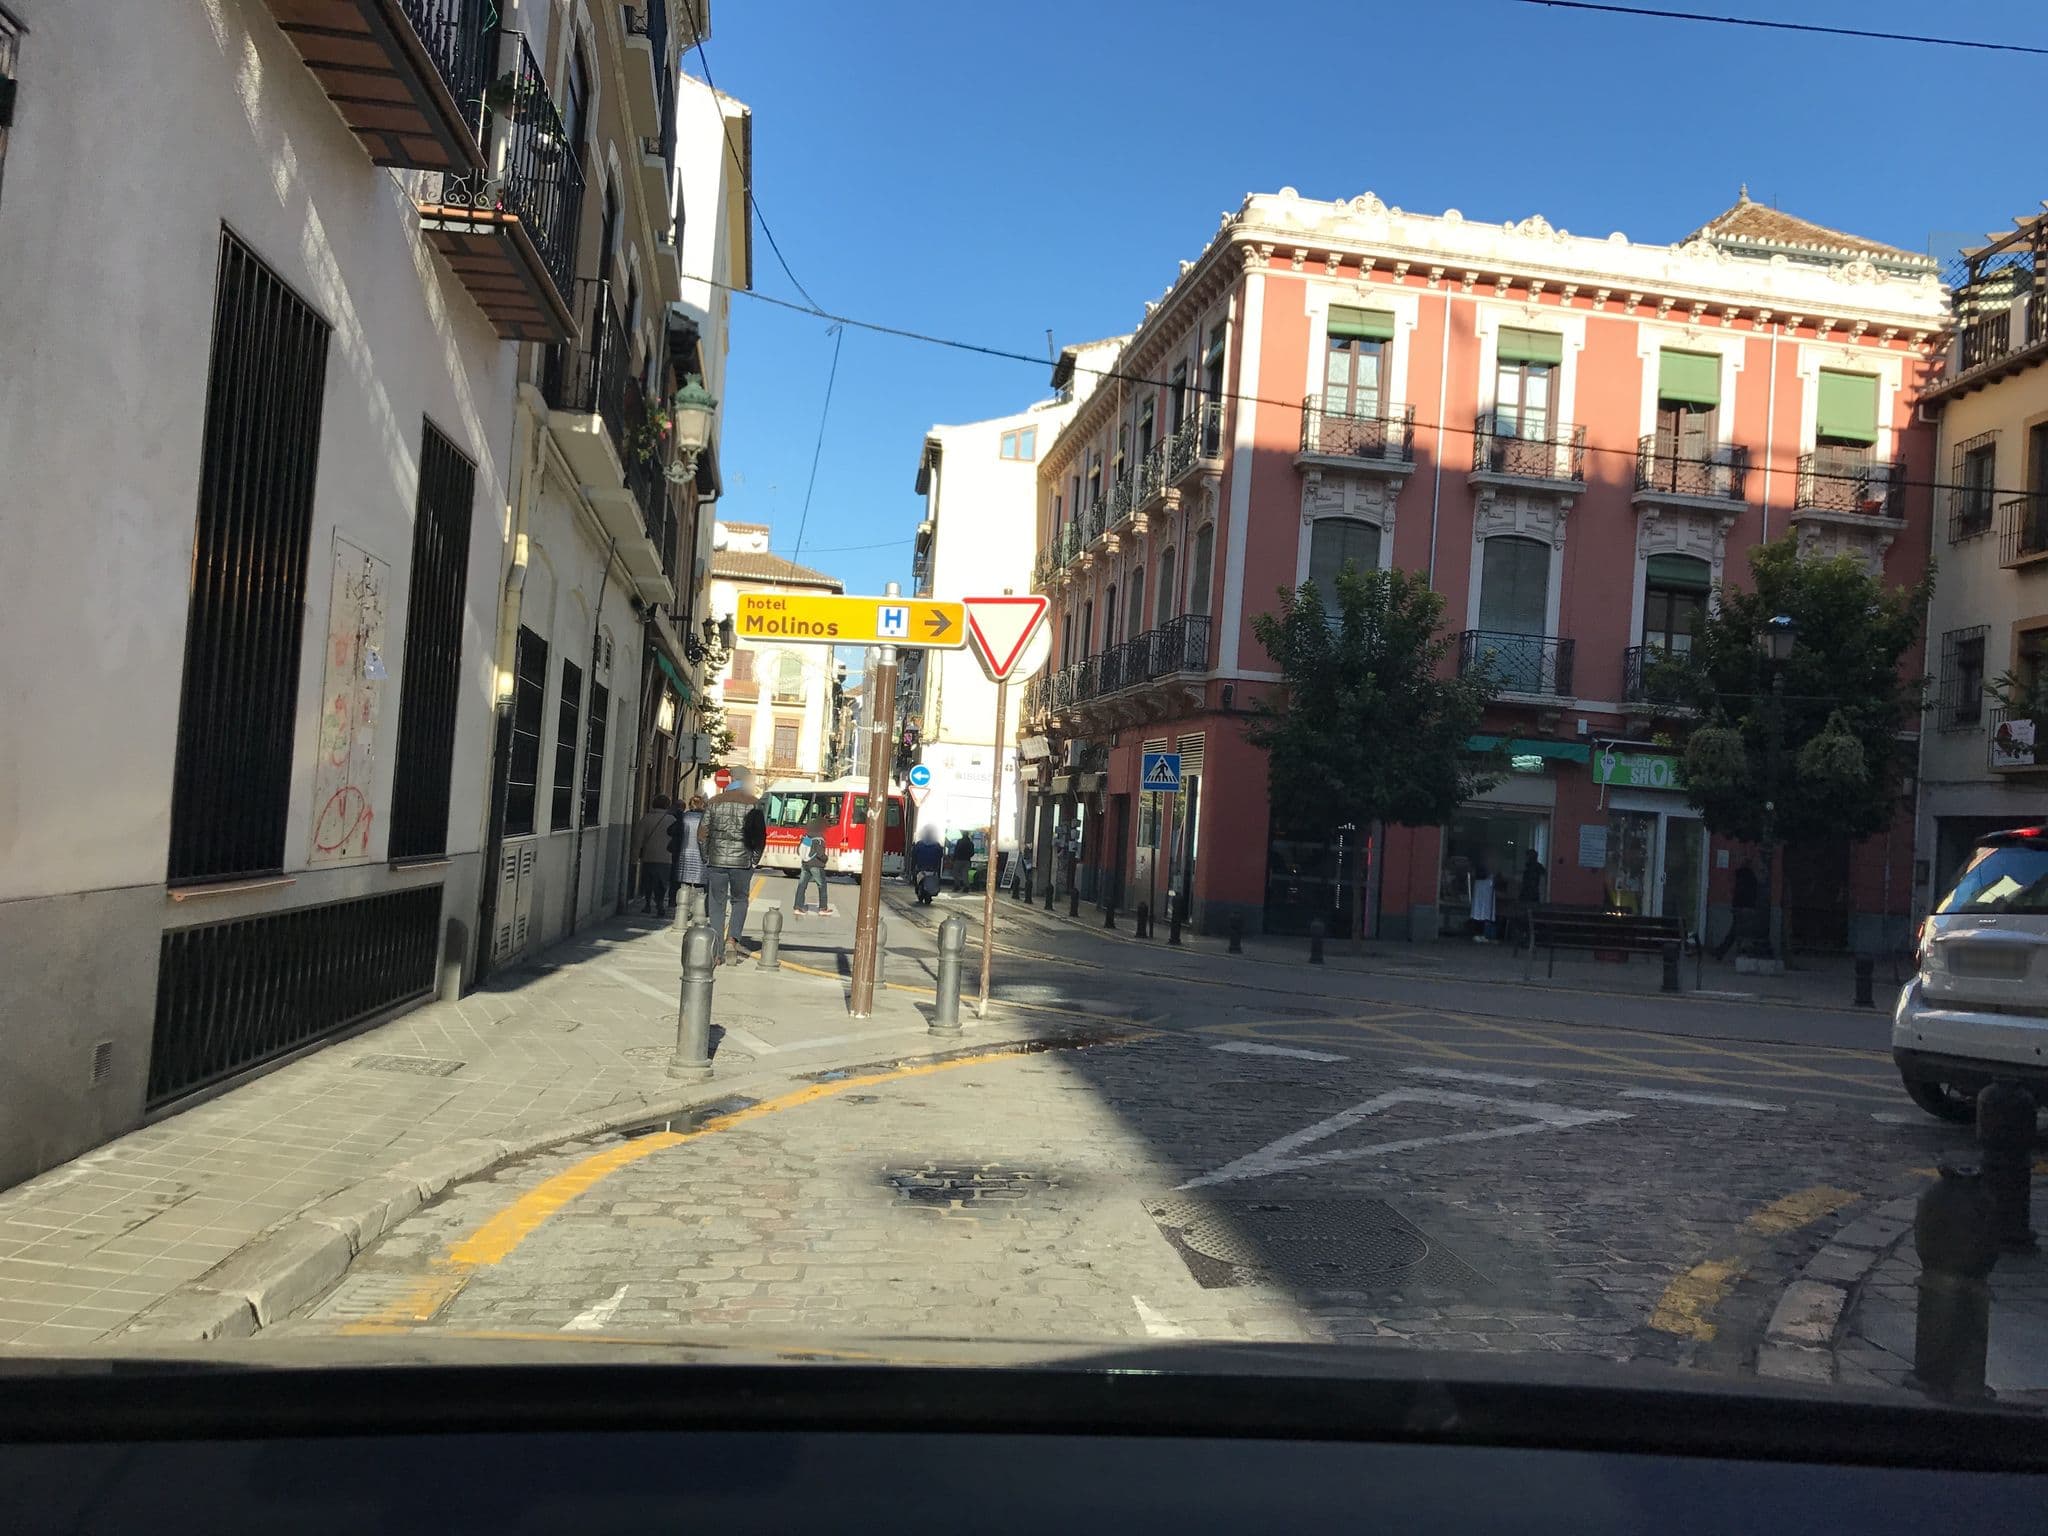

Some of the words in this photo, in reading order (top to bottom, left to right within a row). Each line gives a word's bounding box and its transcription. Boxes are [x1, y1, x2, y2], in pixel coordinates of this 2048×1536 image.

[747, 597, 787, 610] hotel
[745, 614, 839, 636] Molinos
[884, 608, 902, 629] H
